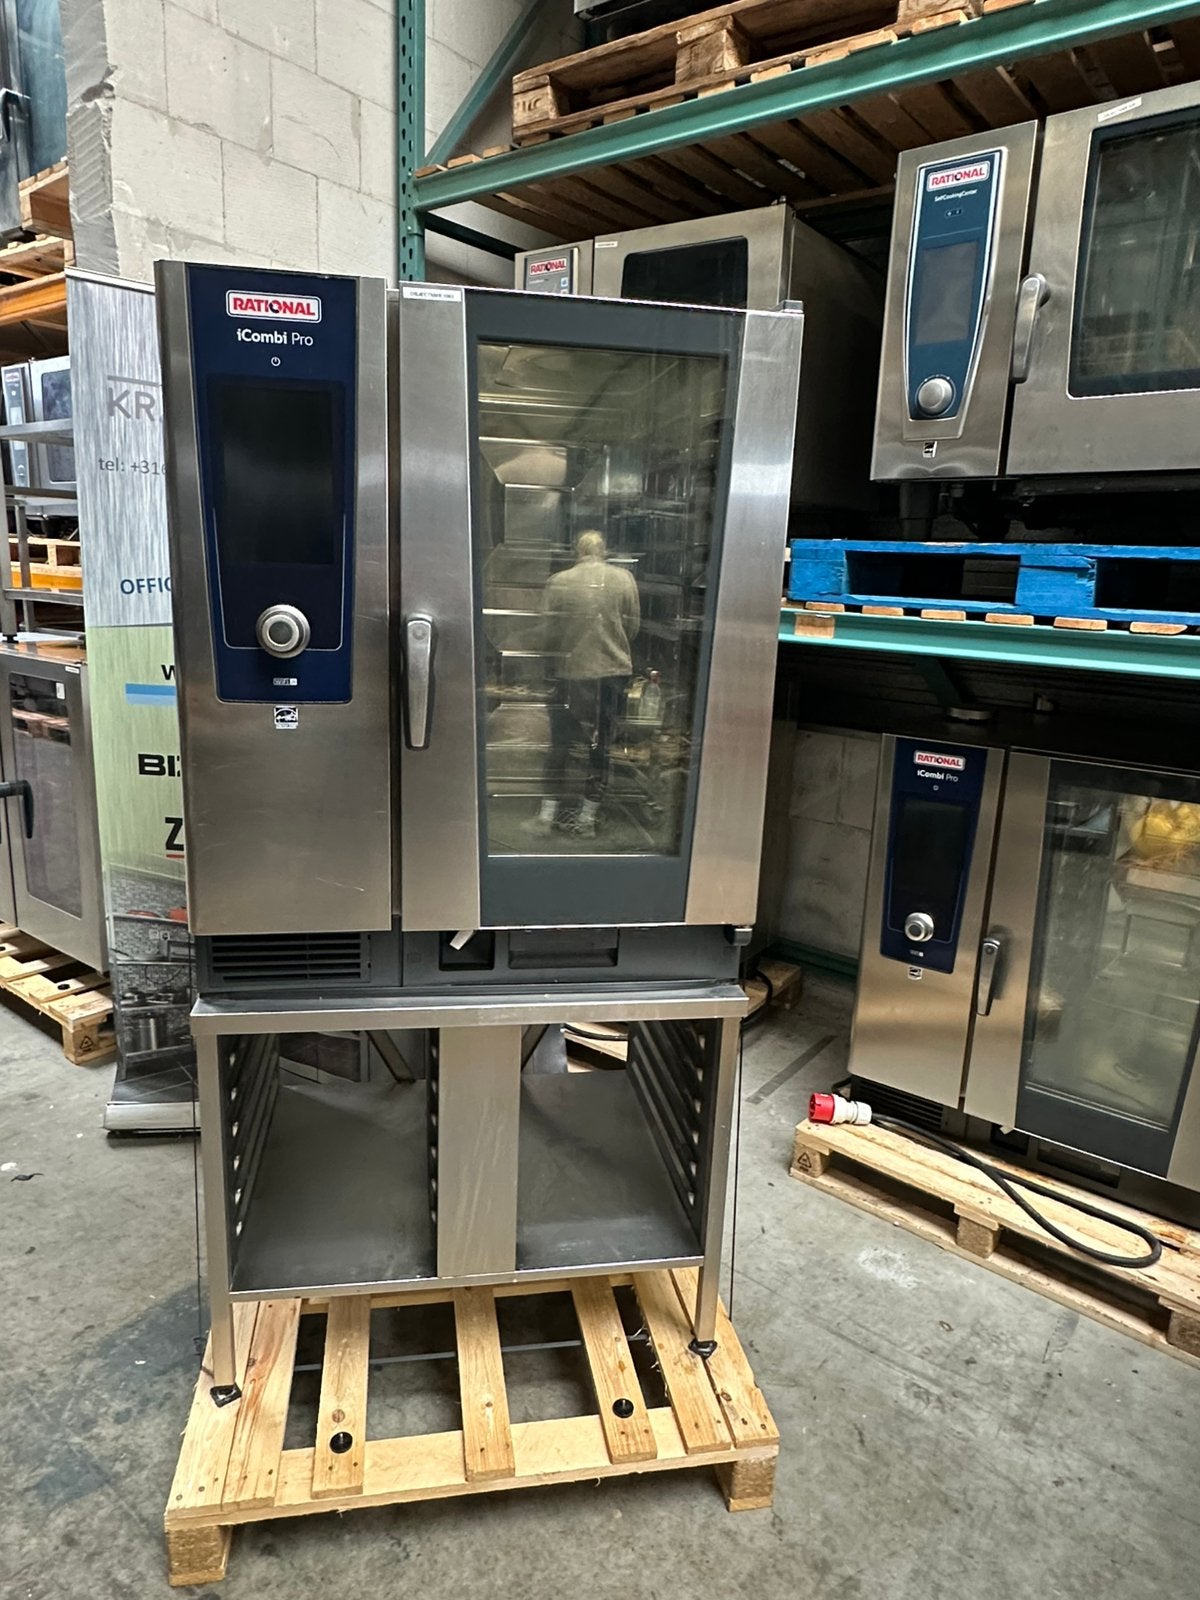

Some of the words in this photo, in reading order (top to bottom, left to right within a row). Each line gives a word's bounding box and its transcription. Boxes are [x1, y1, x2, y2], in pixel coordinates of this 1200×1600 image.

[931, 168, 985, 186] RATIONAL
[530, 260, 566, 274] RATIONAL
[233, 297, 316, 316] RATIONAL
[236, 328, 288, 345] iCombi
[291, 332, 314, 346] Pro
[98, 457, 124, 472] tel:
[138, 753, 181, 777] BI
[917, 754, 961, 766] RATIONAL
[917, 769, 944, 780] iCombi
[945, 773, 959, 782] Pro
